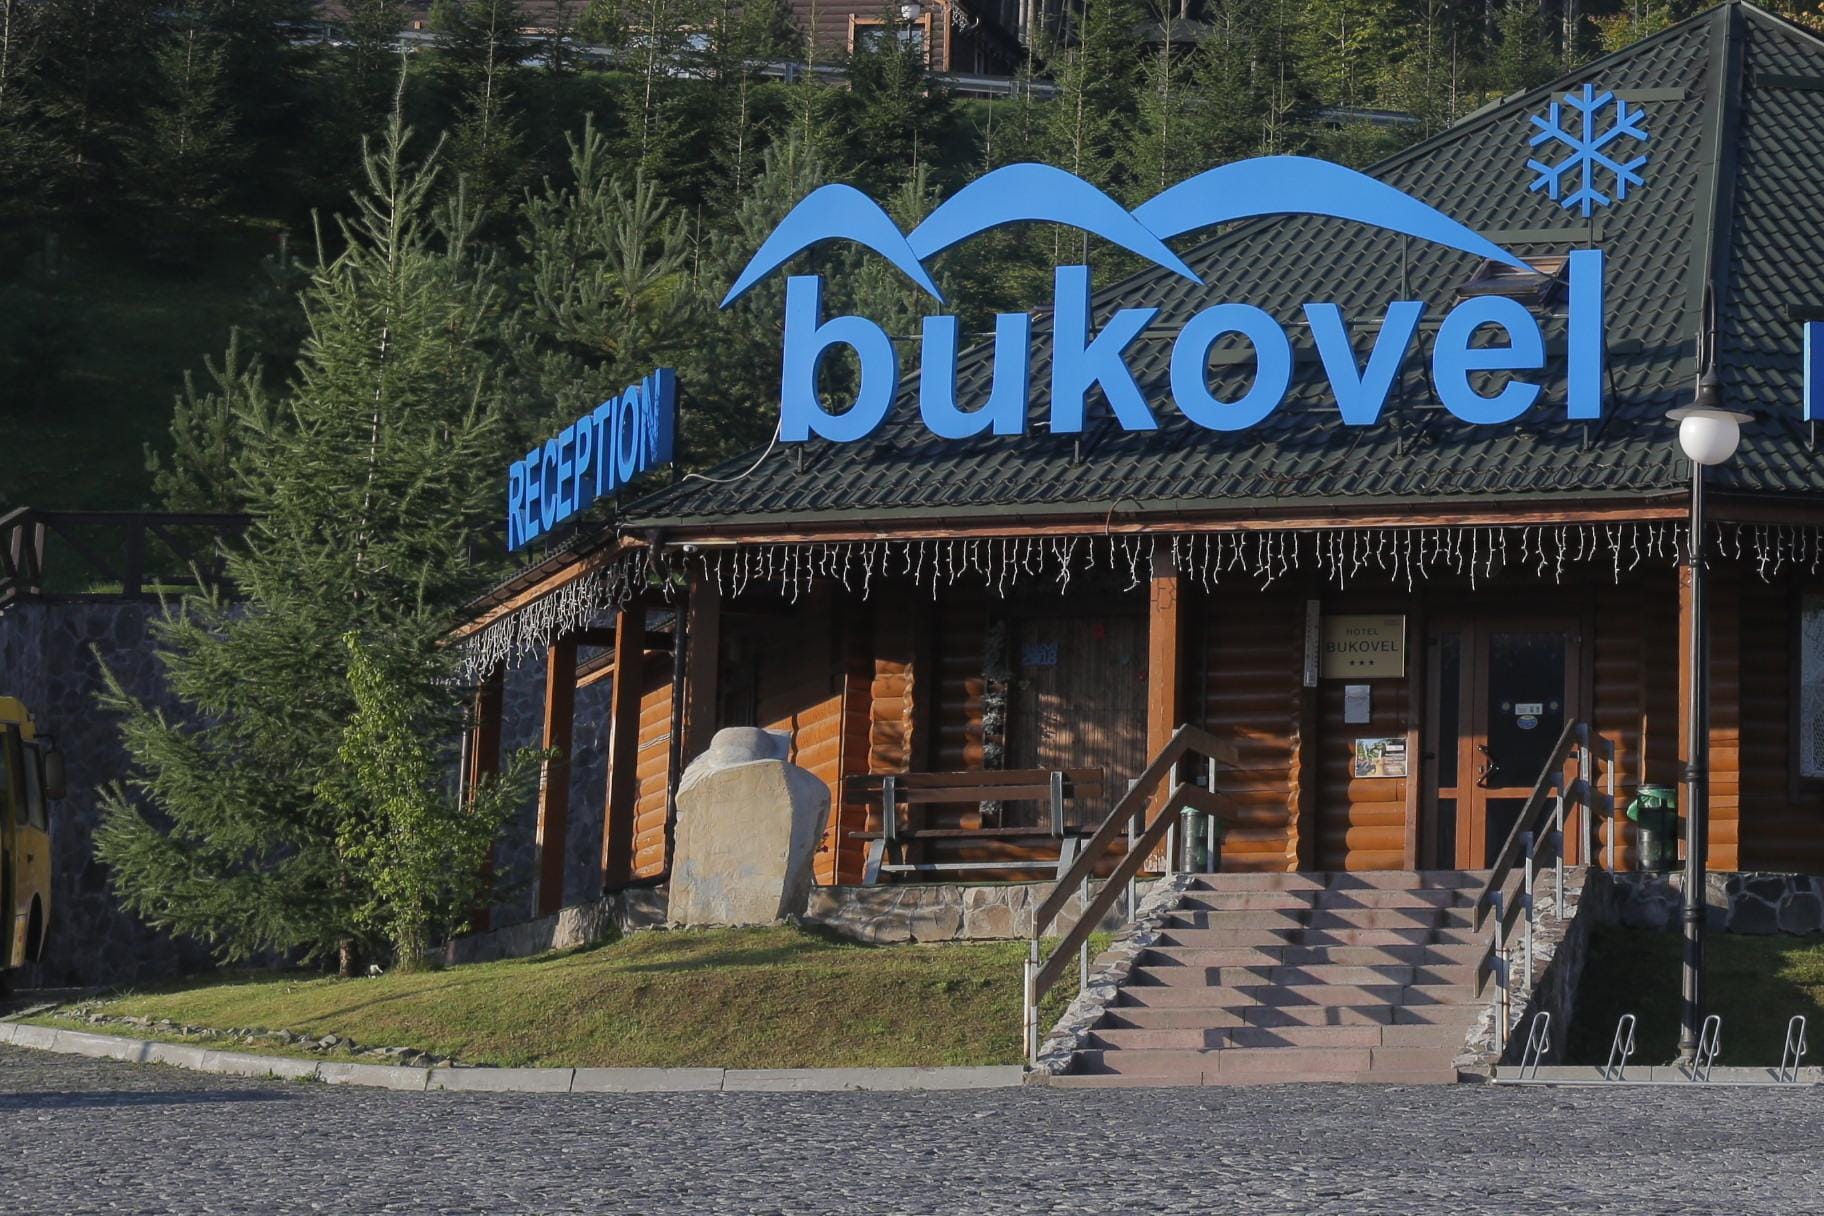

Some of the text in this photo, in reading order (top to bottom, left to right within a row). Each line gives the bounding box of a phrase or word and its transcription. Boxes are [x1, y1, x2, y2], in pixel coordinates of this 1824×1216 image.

[779, 247, 1604, 444] bukovel
[508, 367, 676, 553] RECEPTION
[1326, 639, 1400, 653] BUKOVEL
[1346, 627, 1379, 636] HOTEL
